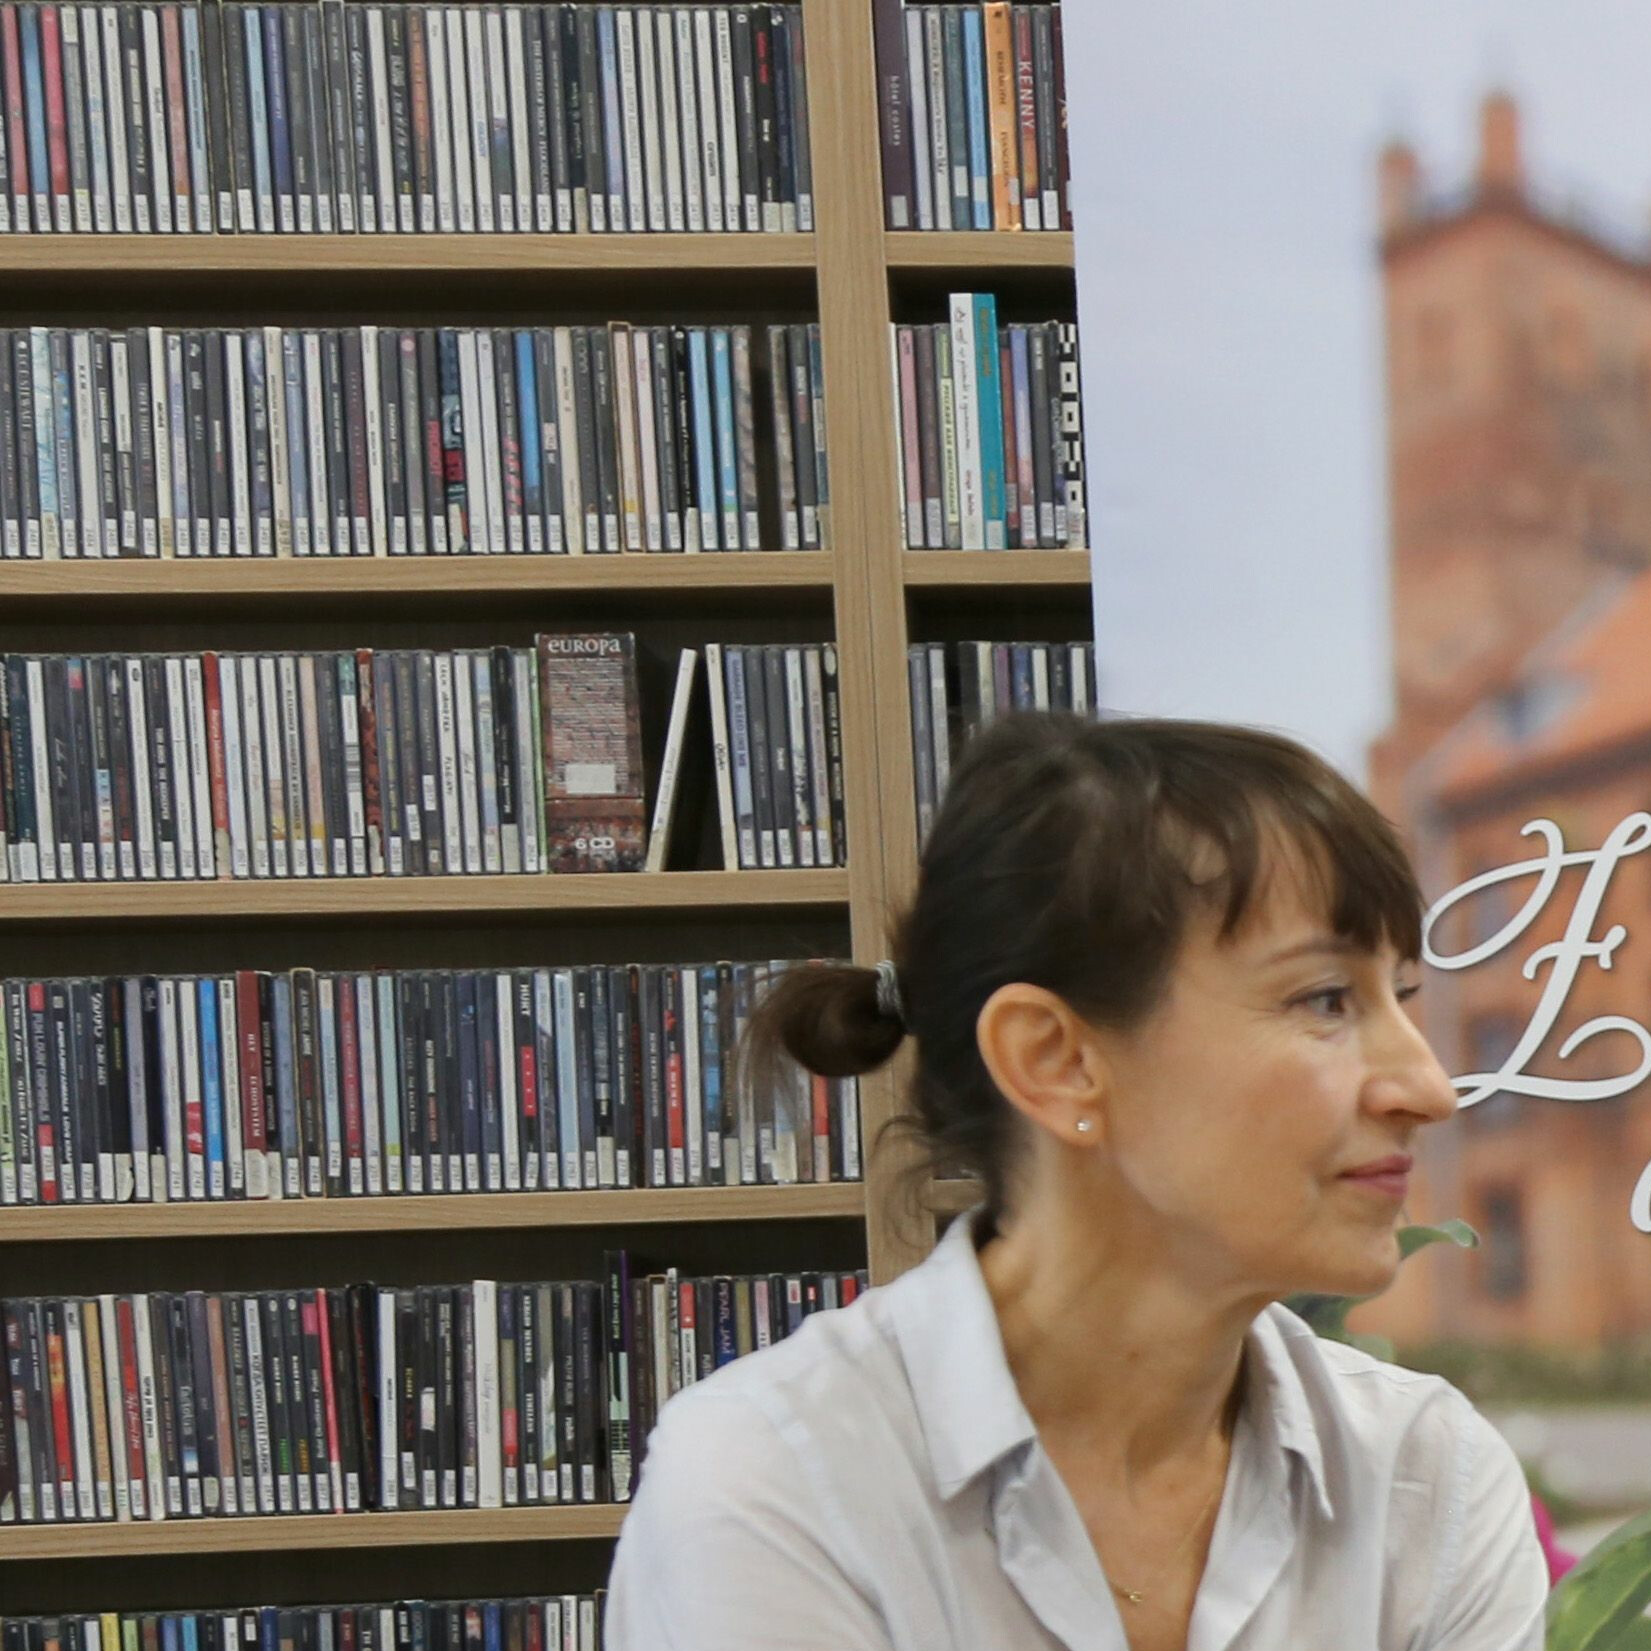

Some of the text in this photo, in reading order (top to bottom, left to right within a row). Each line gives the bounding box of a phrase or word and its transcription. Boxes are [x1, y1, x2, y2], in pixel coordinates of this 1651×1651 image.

[1019, 61, 1035, 129] KENNY
[520, 984, 530, 1016] HURT
[719, 1282, 731, 1354] PEARL JAM
